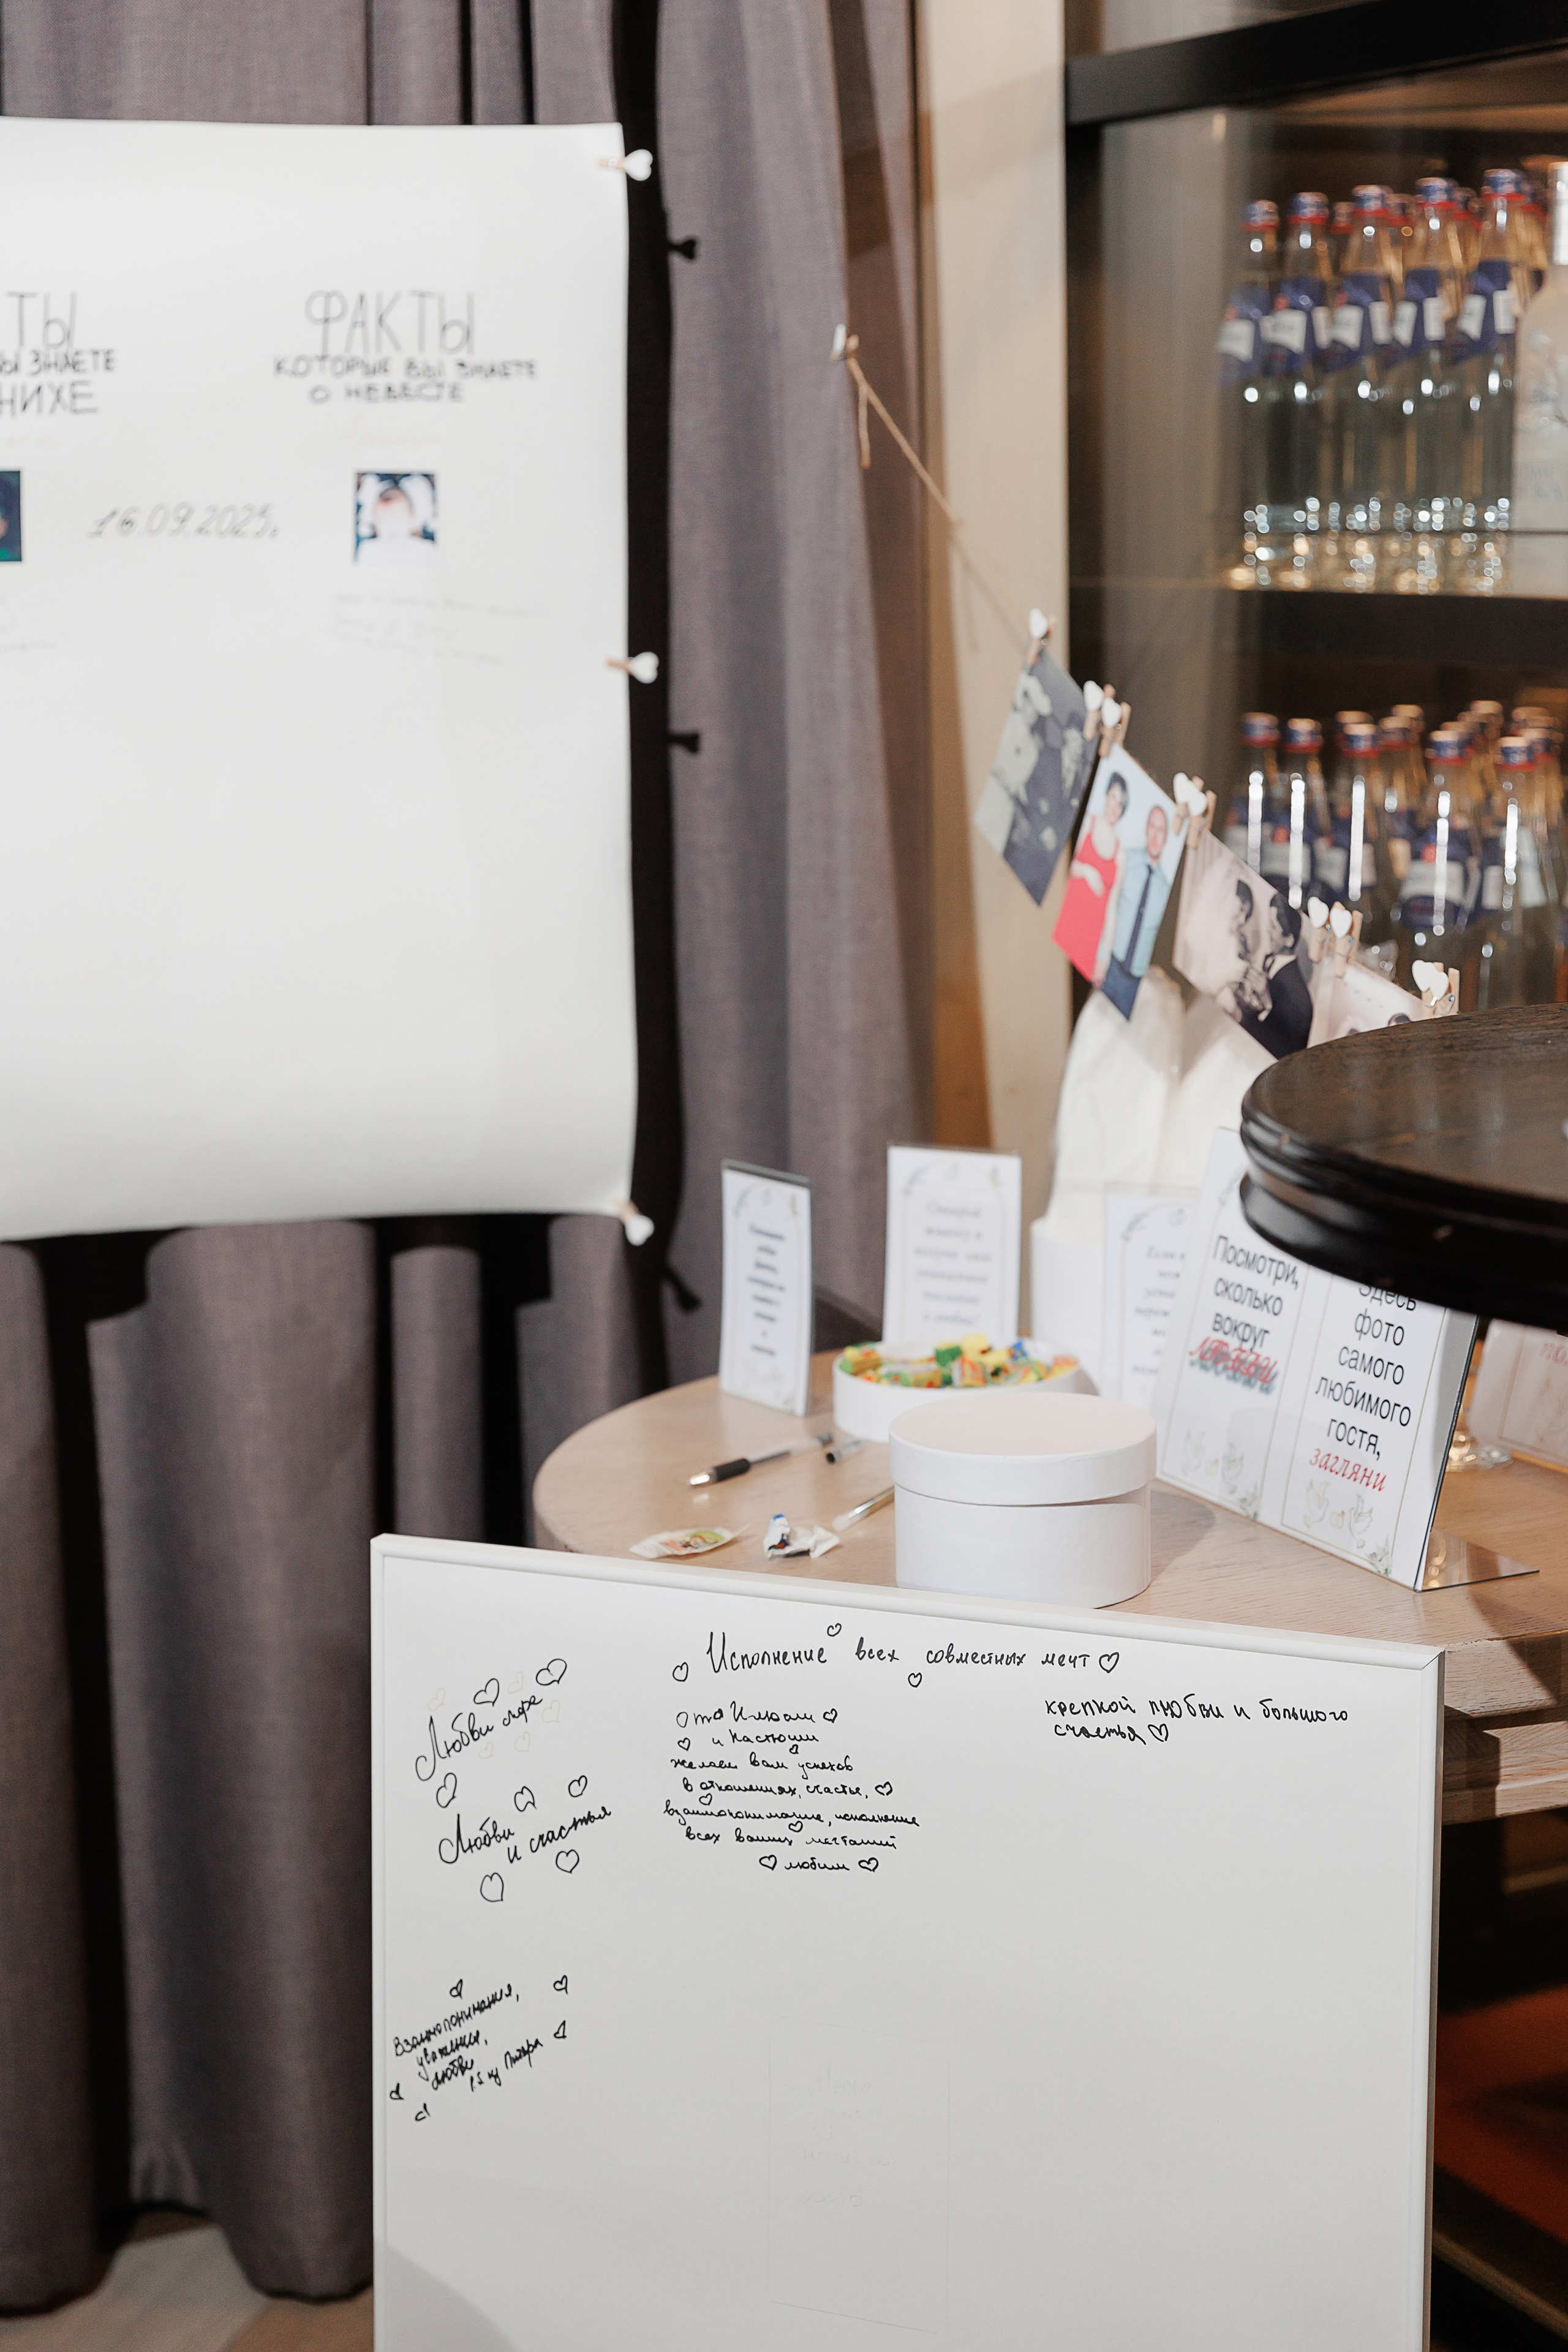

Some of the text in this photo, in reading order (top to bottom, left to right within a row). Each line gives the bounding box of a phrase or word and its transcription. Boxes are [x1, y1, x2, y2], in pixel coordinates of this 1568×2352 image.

[304, 290, 475, 354] ФАКТЫ
[29, 349, 116, 375] ЗНАЕТЕ
[273, 354, 538, 380] КОТОРЫЕ ВЫ ЗНАЕТЕ
[308, 382, 466, 404] О НЕВЕСТЕ
[1212, 1235, 1299, 1291] Посмотри,
[1215, 1276, 1284, 1317] сколько
[1212, 1313, 1270, 1351] вокруг
[1354, 1308, 1404, 1346] фото
[1338, 1345, 1404, 1385] самого
[1316, 1375, 1411, 1427] любимого
[1327, 1417, 1381, 1460] гостя,
[1308, 1447, 1387, 1493] загляни
[706, 1632, 827, 1673] Исполнение
[855, 1637, 899, 1662] всех
[927, 1643, 1027, 1666] совместных
[1044, 1693, 1348, 1723] крепкой любви и большого
[415, 1713, 494, 1781] Любви
[712, 1737, 724, 1747] и
[683, 1777, 693, 1793] в
[438, 1813, 515, 1864] Любви
[507, 1845, 522, 1864] и
[685, 1825, 721, 1845] всех
